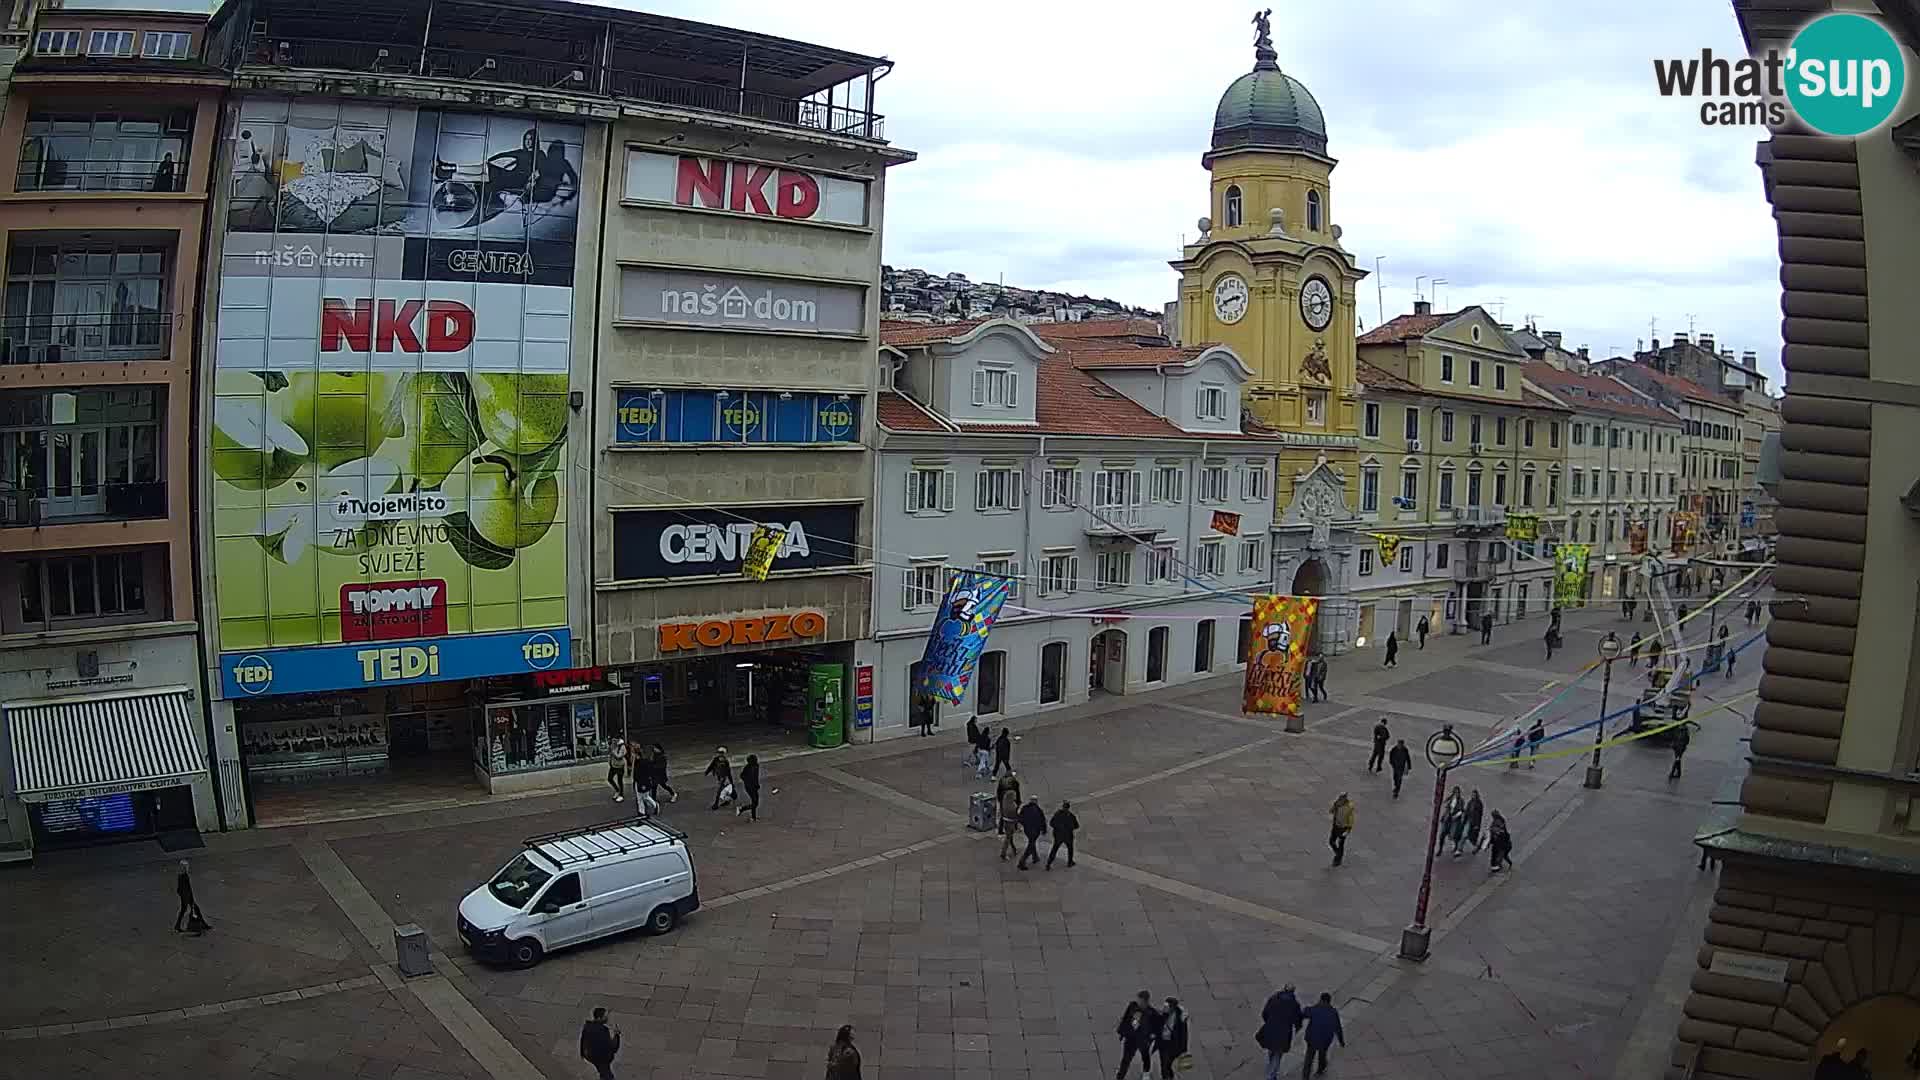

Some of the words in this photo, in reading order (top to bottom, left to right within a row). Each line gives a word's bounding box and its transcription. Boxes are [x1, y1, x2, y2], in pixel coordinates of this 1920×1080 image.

[675, 157, 820, 220] NKD
[254, 244, 295, 267] naš
[318, 246, 366, 268] dom
[448, 249, 535, 274] CENTRA
[660, 283, 718, 316] naš
[753, 287, 817, 322] dom
[320, 298, 477, 353] NKD
[617, 407, 658, 426] TEDi
[723, 408, 760, 426] TEDi
[819, 410, 853, 427] TEDi
[338, 496, 446, 516] #TvojeMisto
[333, 528, 357, 548] ZA
[366, 524, 450, 548] DNEVNO
[359, 547, 426, 574] SVJEŽE
[348, 586, 439, 614] TOMMY
[659, 611, 827, 653] KORZO
[522, 642, 560, 660] TEDi
[232, 665, 273, 683] TEDi
[357, 645, 439, 682] TEDi
